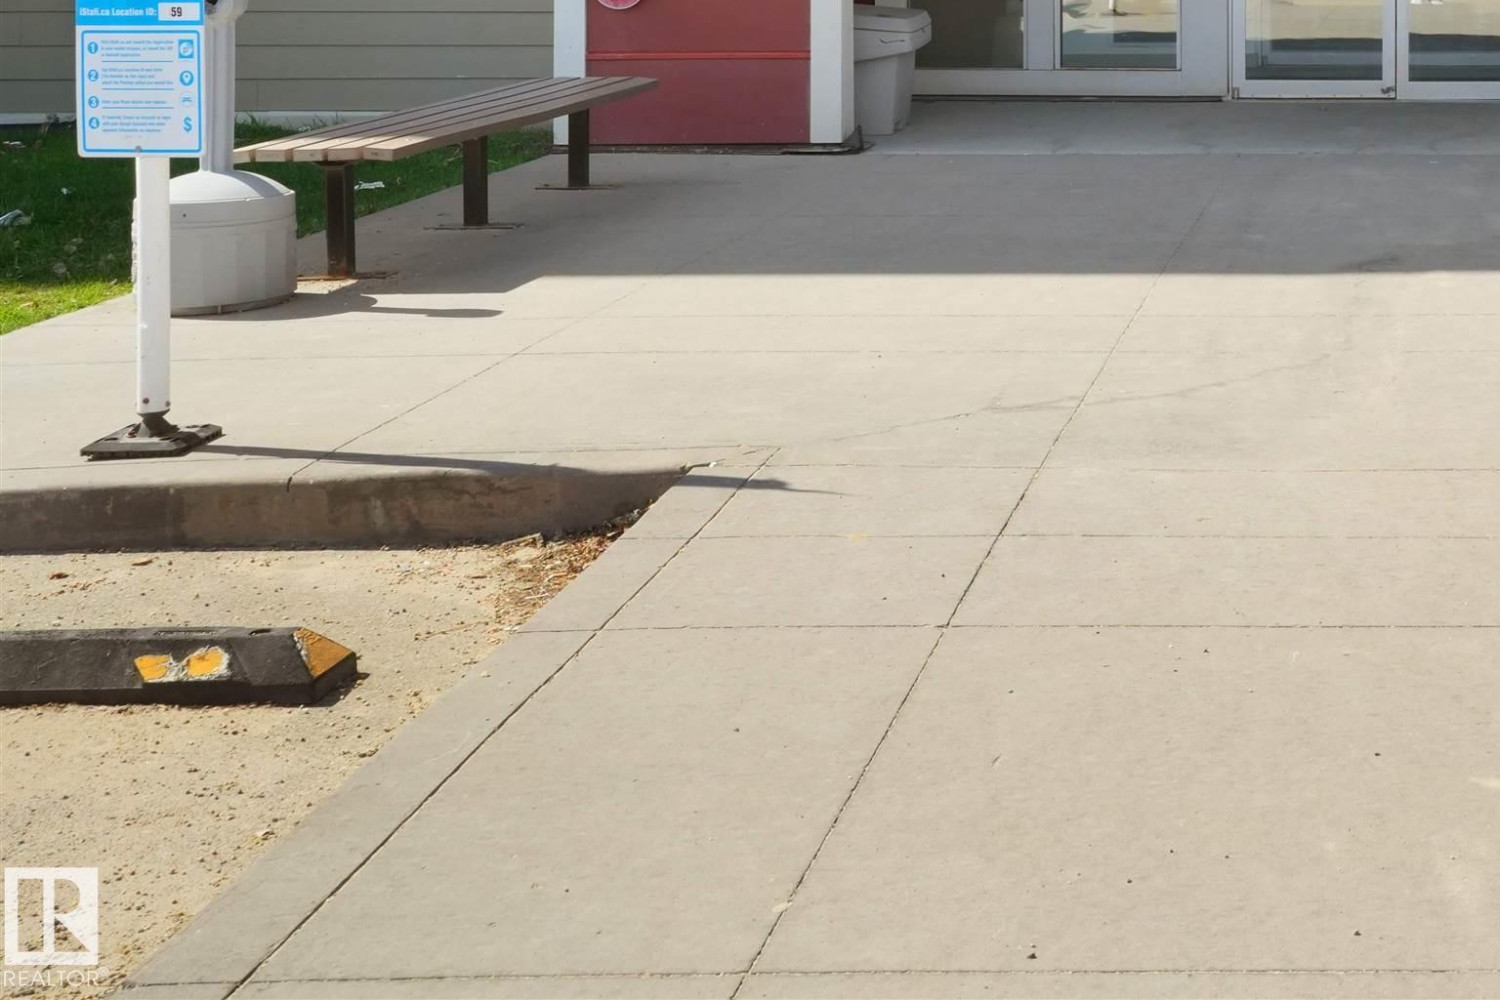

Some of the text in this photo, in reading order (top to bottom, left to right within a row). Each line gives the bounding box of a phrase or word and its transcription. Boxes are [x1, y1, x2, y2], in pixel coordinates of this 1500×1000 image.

[112, 6, 144, 16] Location
[146, 6, 157, 16] ID:
[171, 7, 182, 17] 59
